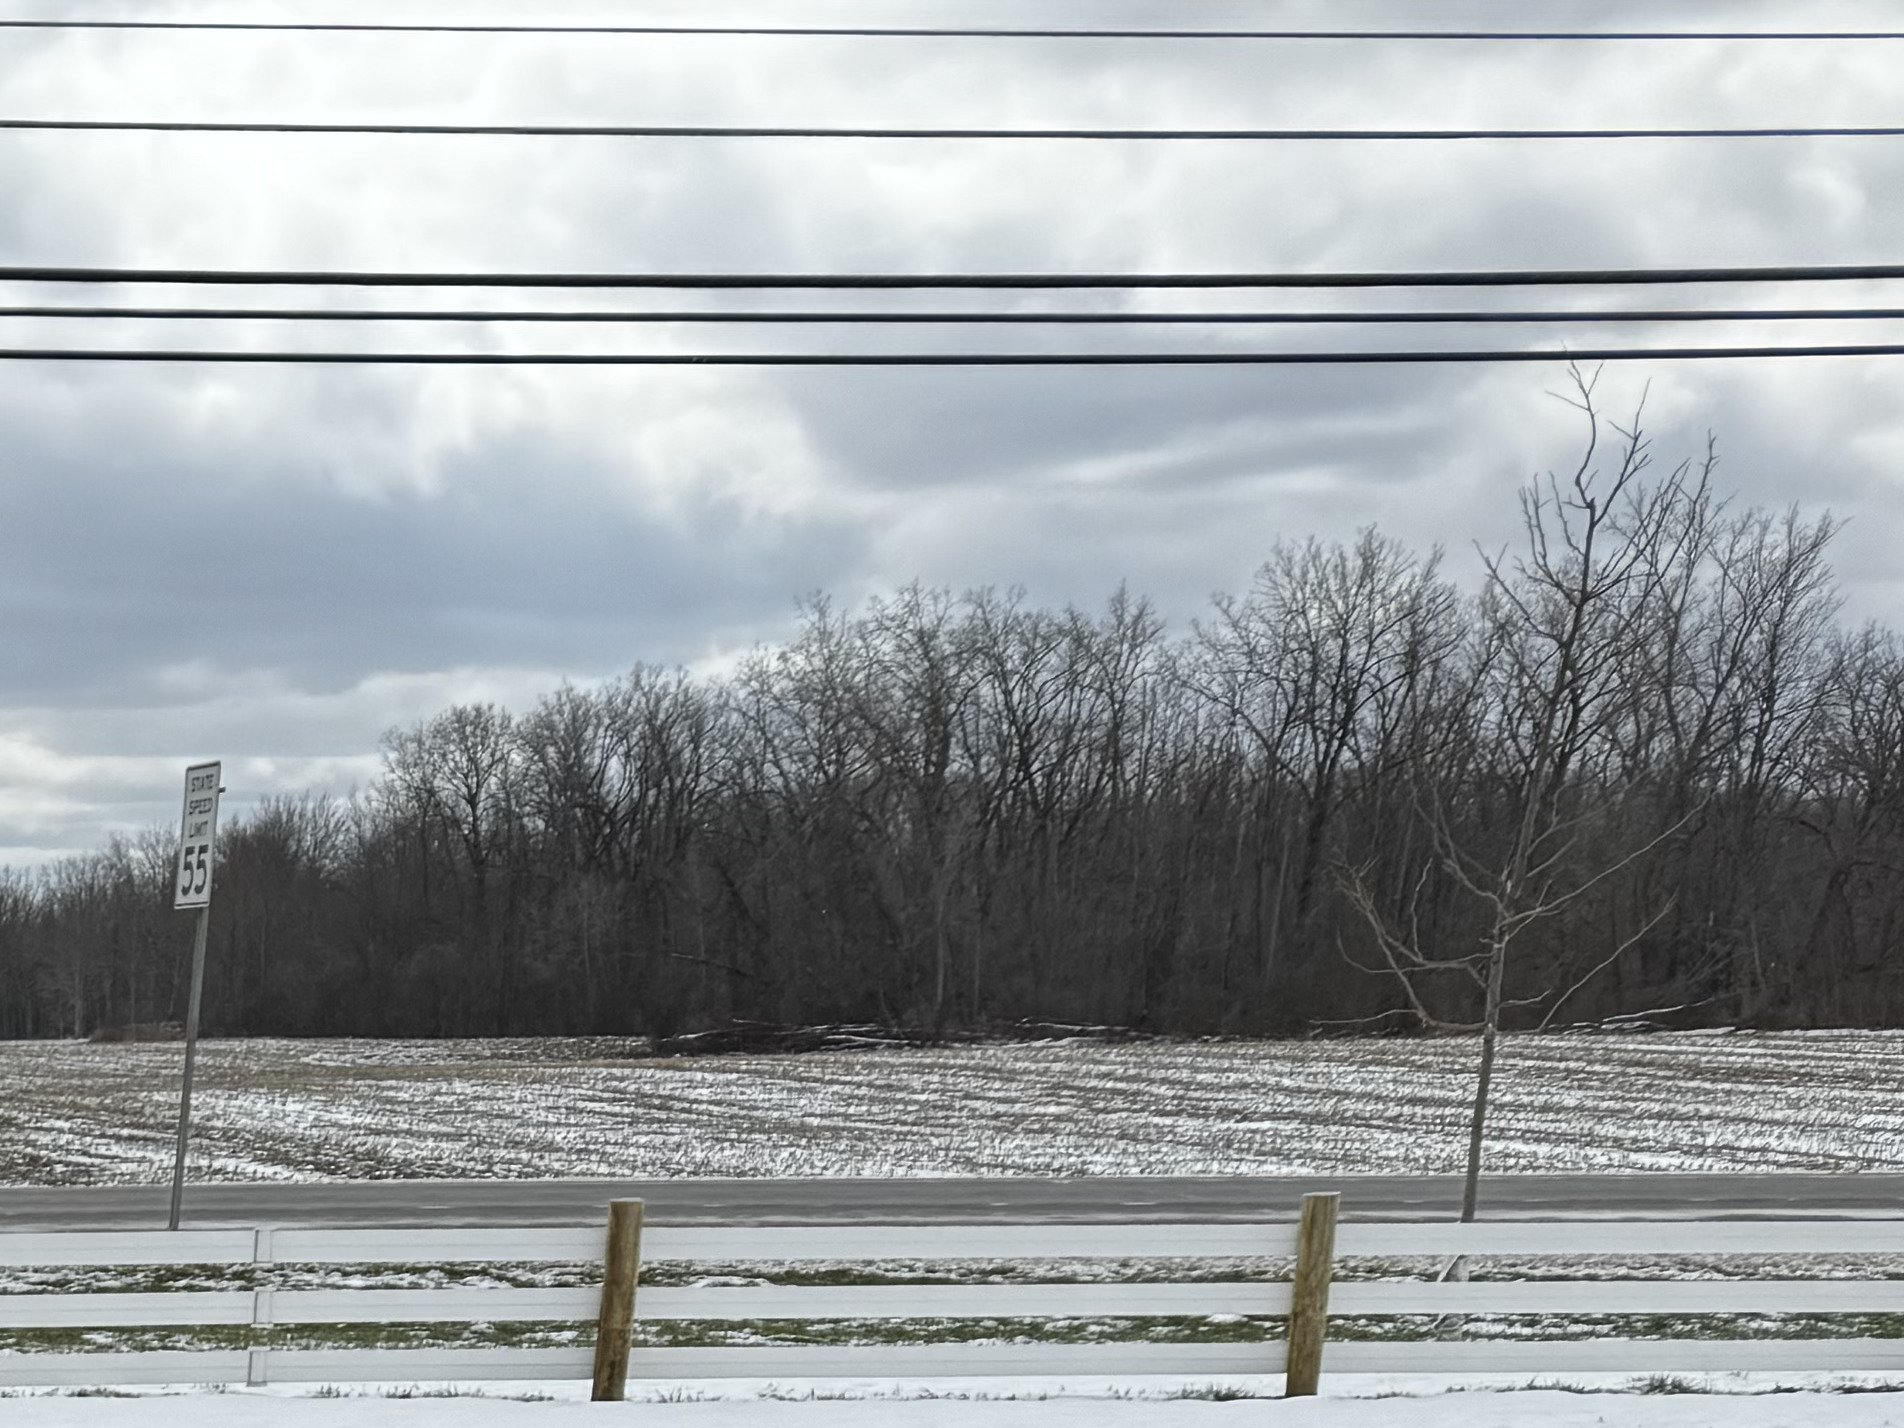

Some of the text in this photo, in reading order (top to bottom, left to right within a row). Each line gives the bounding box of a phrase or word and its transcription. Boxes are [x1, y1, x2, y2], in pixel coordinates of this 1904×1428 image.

[191, 773, 214, 792] STATE
[189, 797, 213, 815] SPEED
[189, 820, 209, 838] LIMIT
[181, 844, 209, 896] 55
